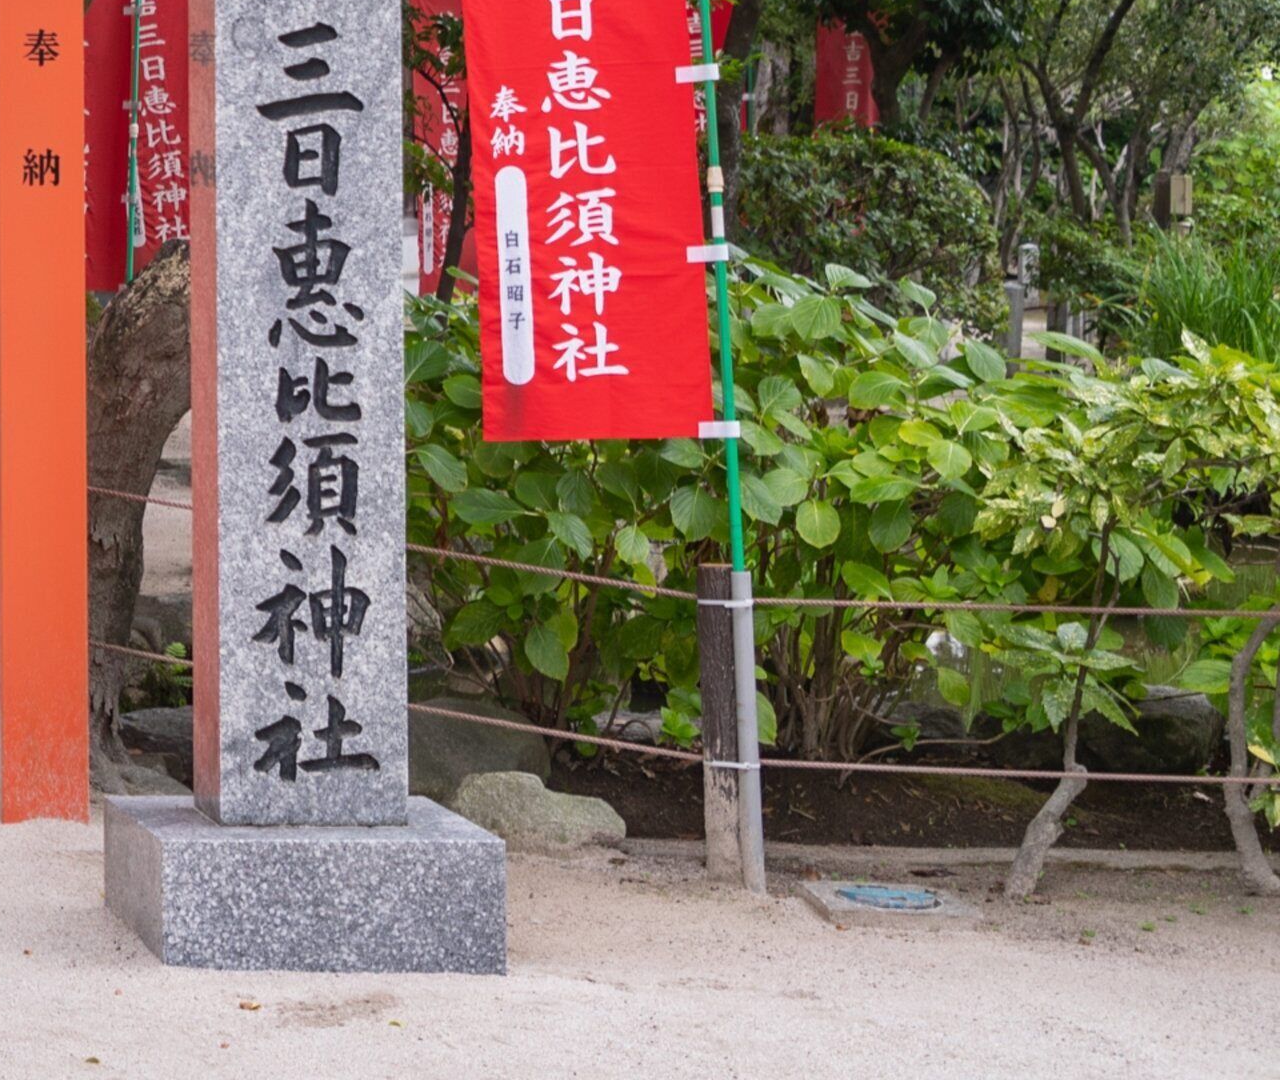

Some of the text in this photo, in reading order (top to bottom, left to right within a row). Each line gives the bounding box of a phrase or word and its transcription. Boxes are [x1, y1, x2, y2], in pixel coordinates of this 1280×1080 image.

[23, 29, 60, 186] 奉納
[490, 85, 527, 158] 奉納
[504, 230, 526, 330] 白石昭子
